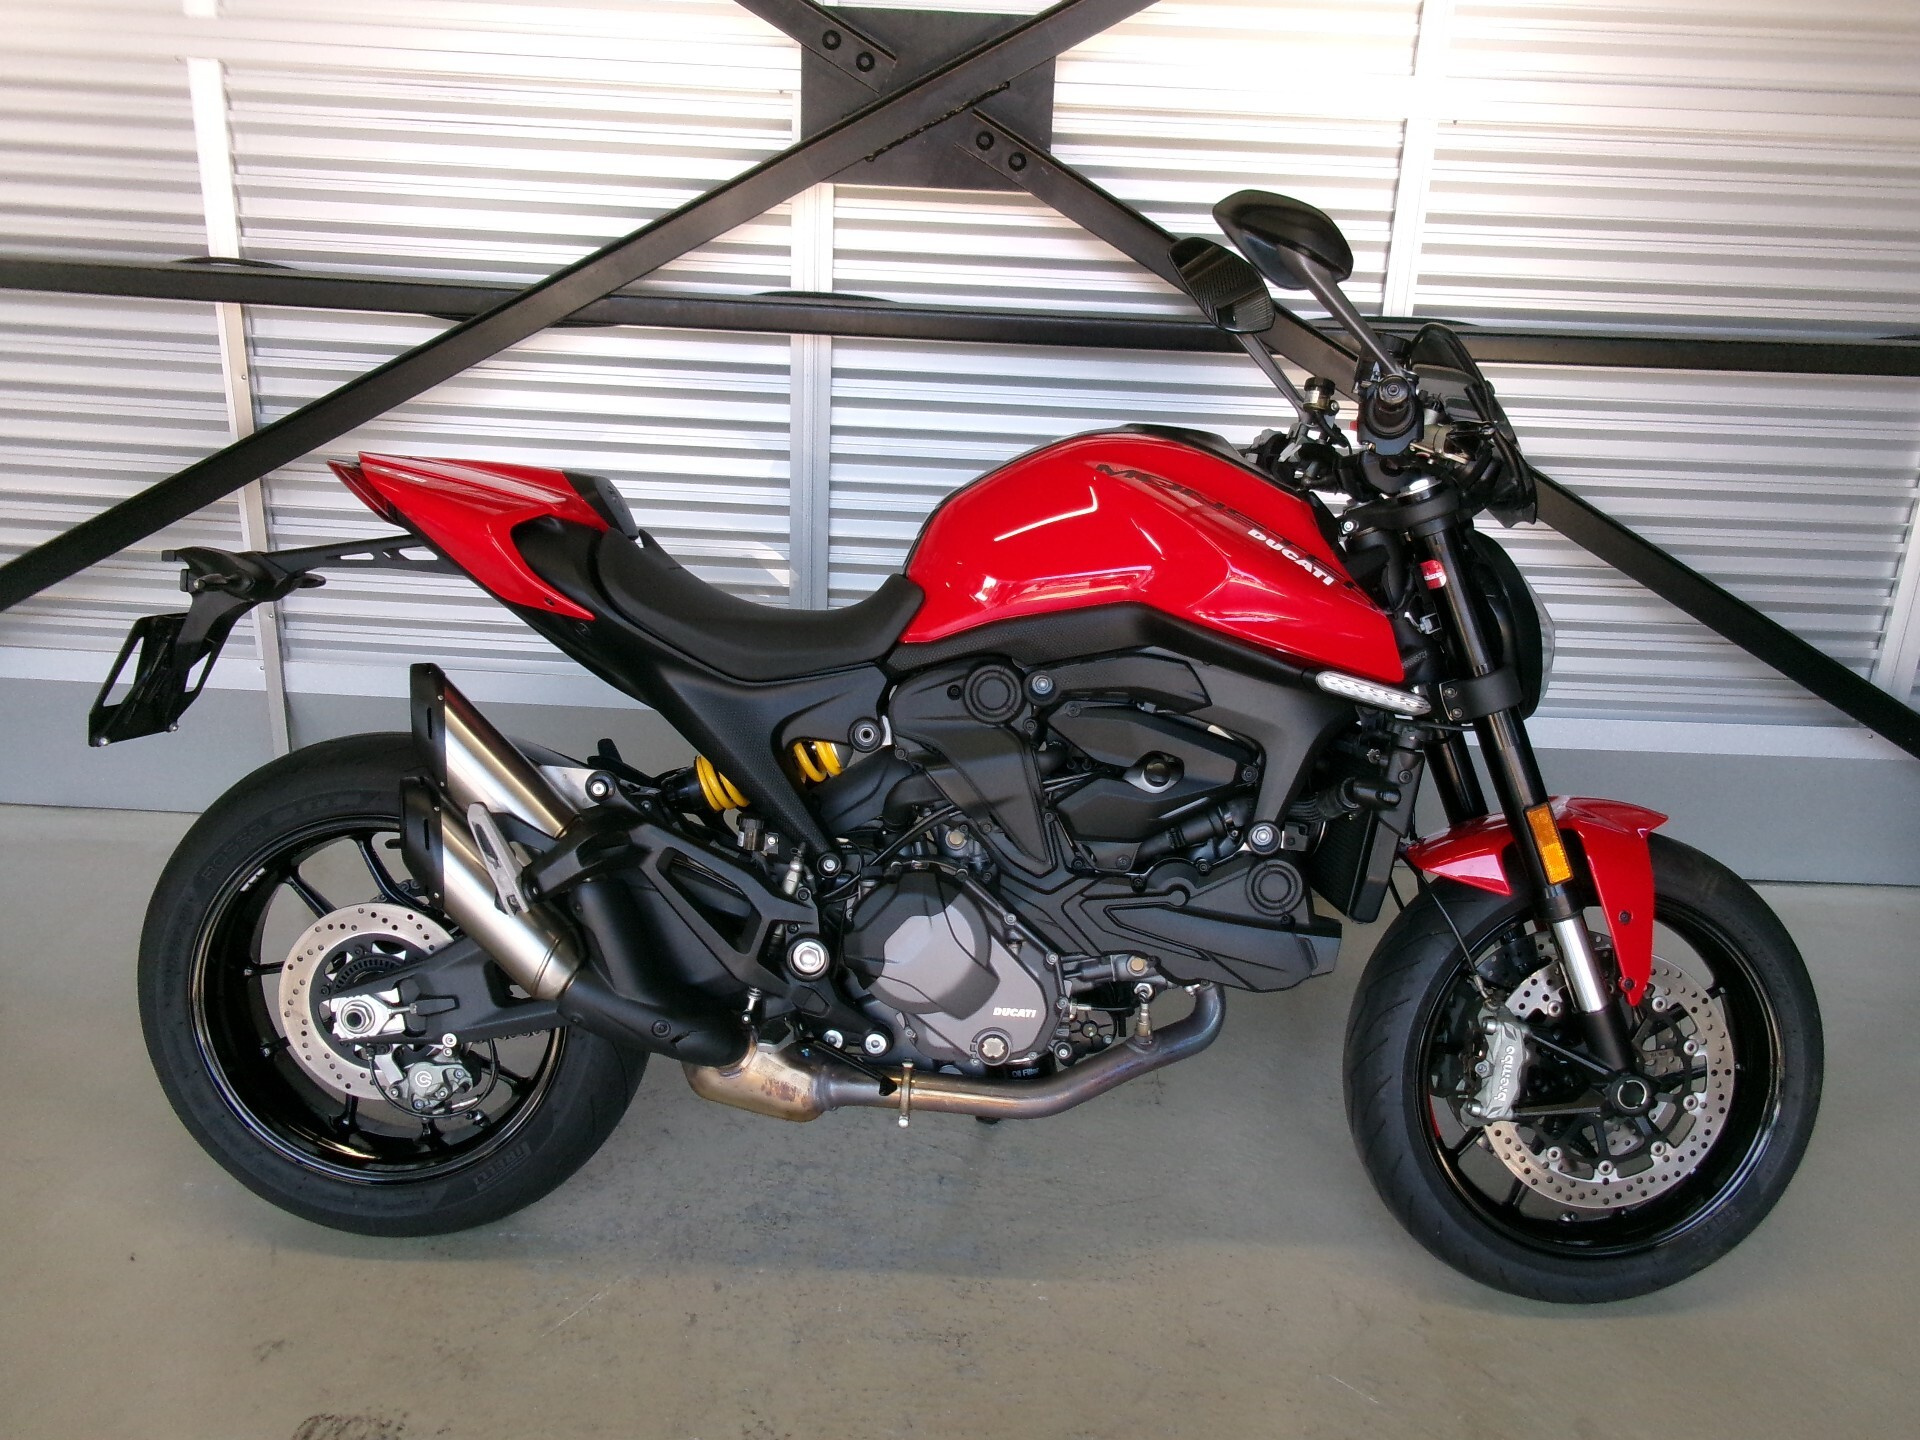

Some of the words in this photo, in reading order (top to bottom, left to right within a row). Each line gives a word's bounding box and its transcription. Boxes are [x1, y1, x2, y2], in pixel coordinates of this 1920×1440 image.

[1247, 528, 1336, 587] DUCATI
[992, 1007, 1037, 1018] DUCATI
[1493, 1045, 1516, 1102] brembo
